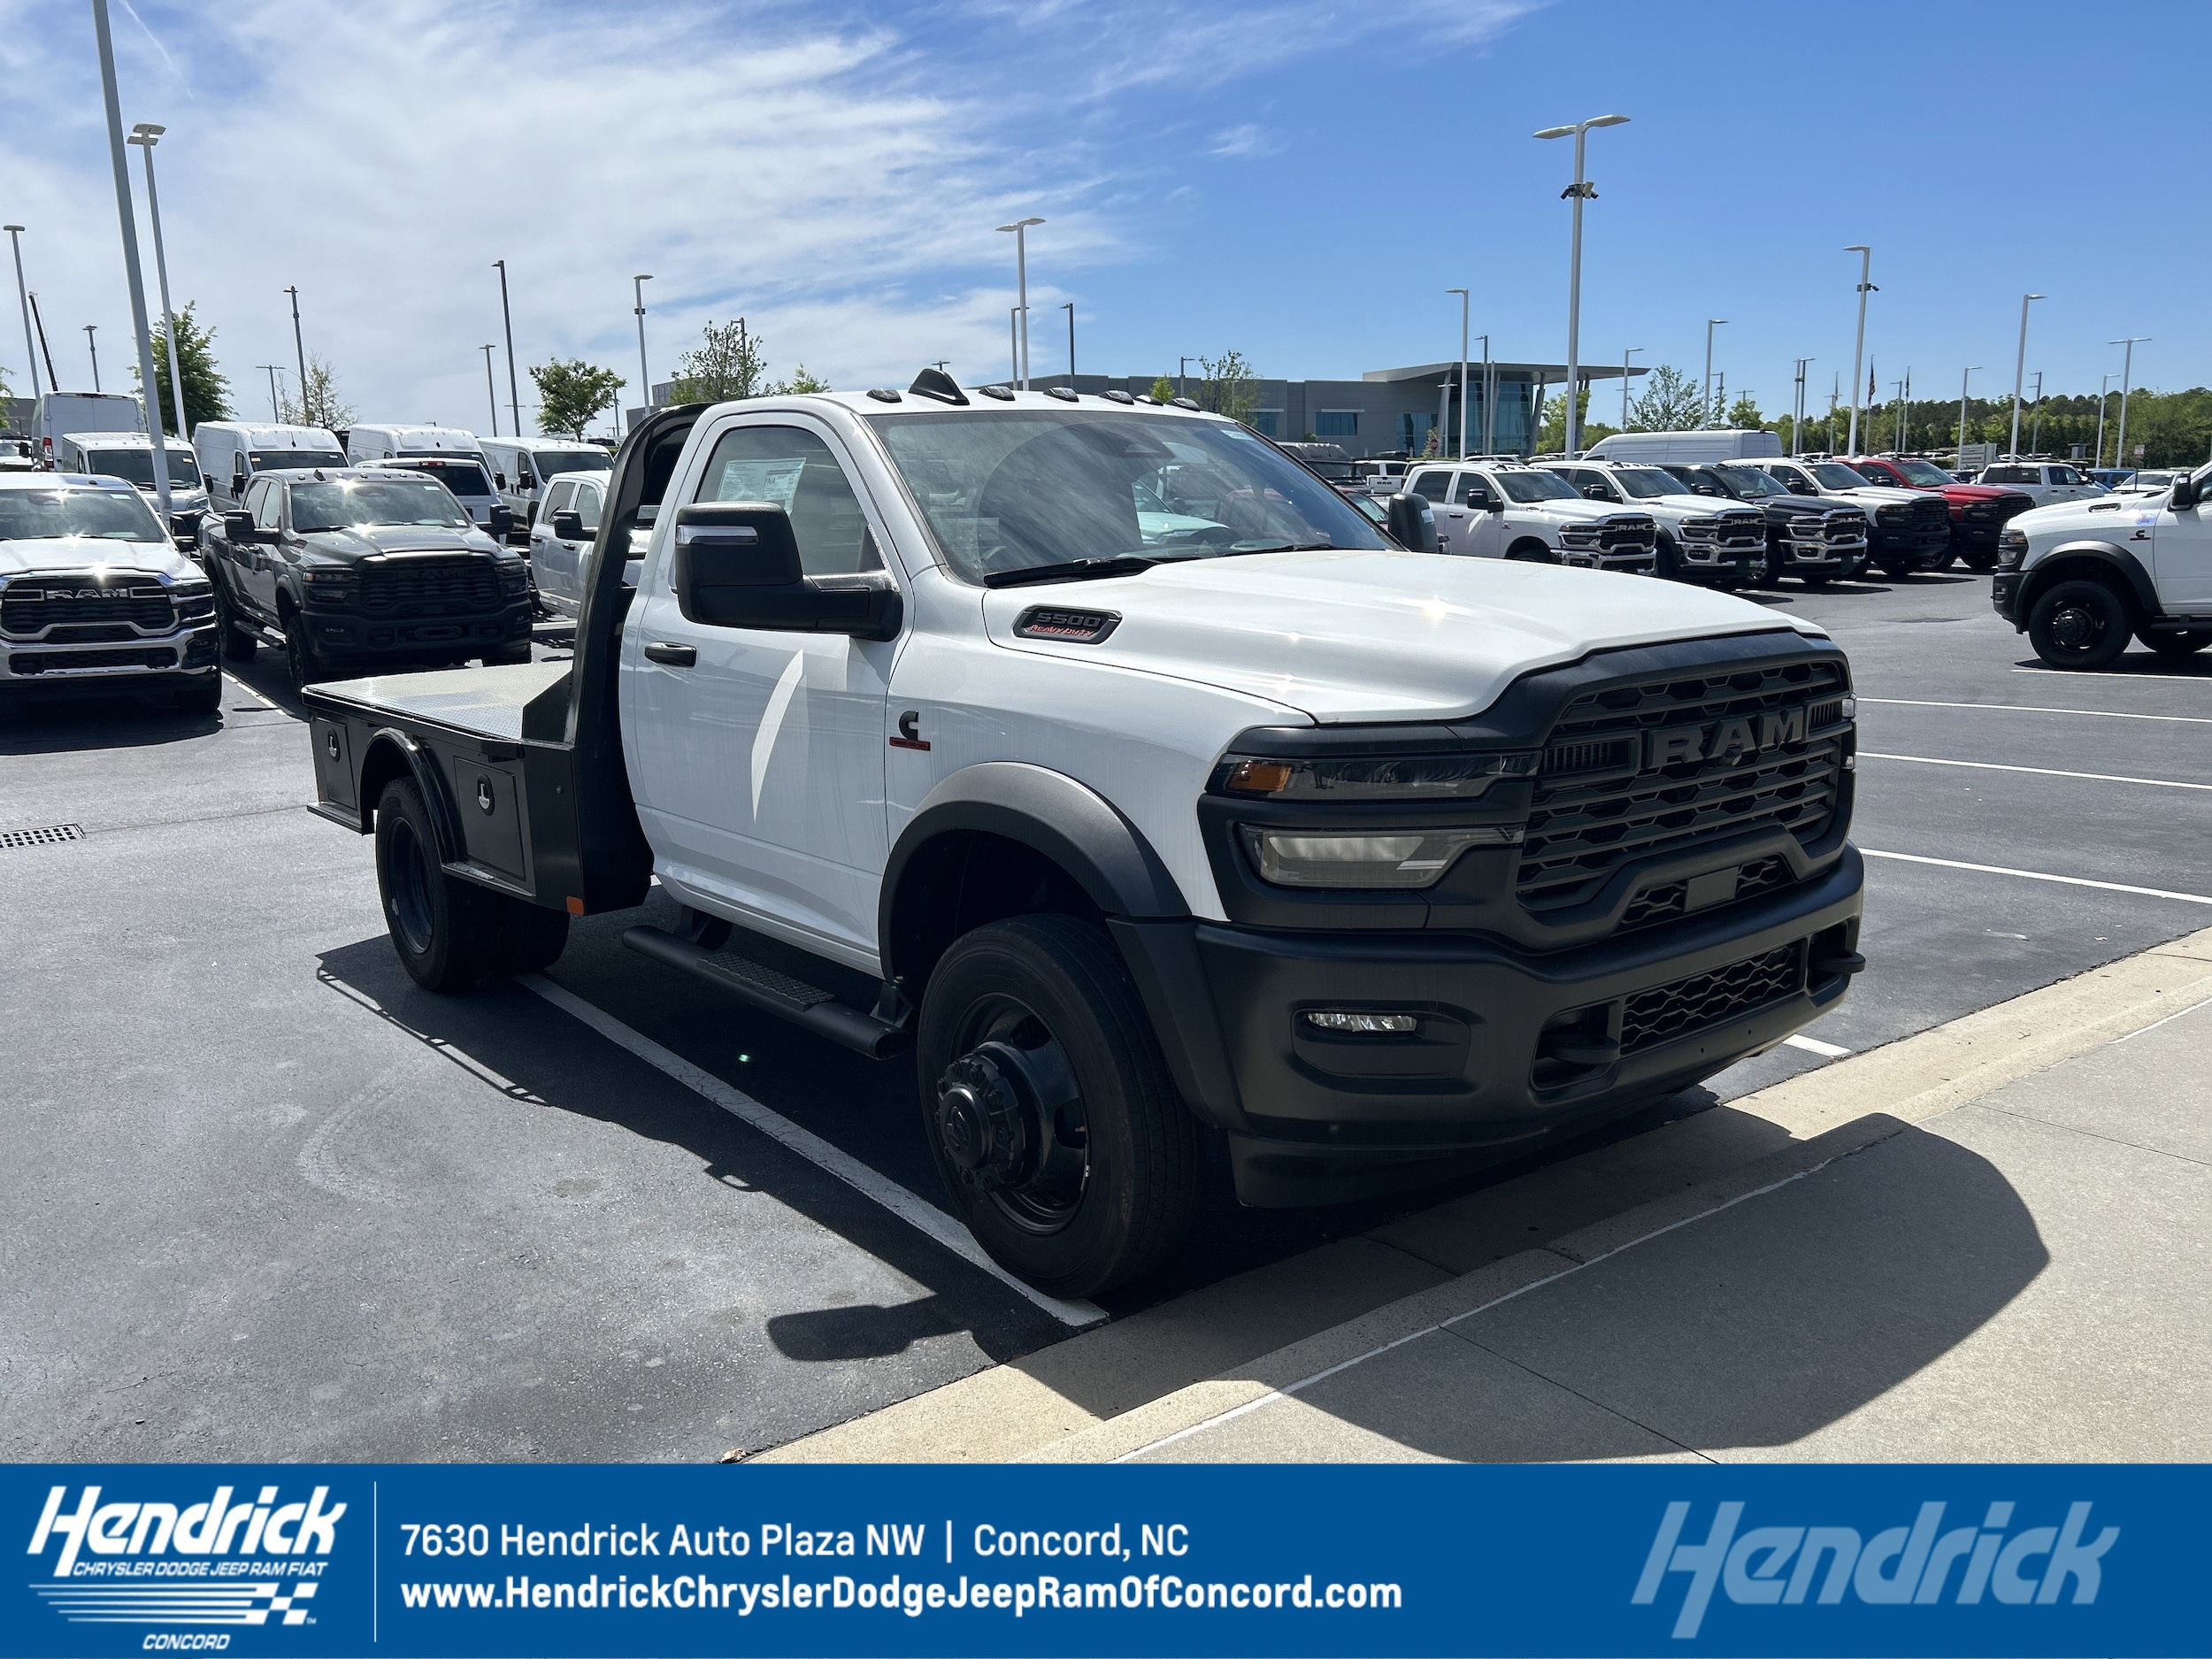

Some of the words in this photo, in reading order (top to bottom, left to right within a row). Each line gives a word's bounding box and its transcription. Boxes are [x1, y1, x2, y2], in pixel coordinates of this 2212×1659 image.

[1617, 523, 1646, 532] RAM
[45, 588, 129, 600] RAM
[1036, 612, 1101, 627] 5500
[1646, 705, 1805, 769] RAM
